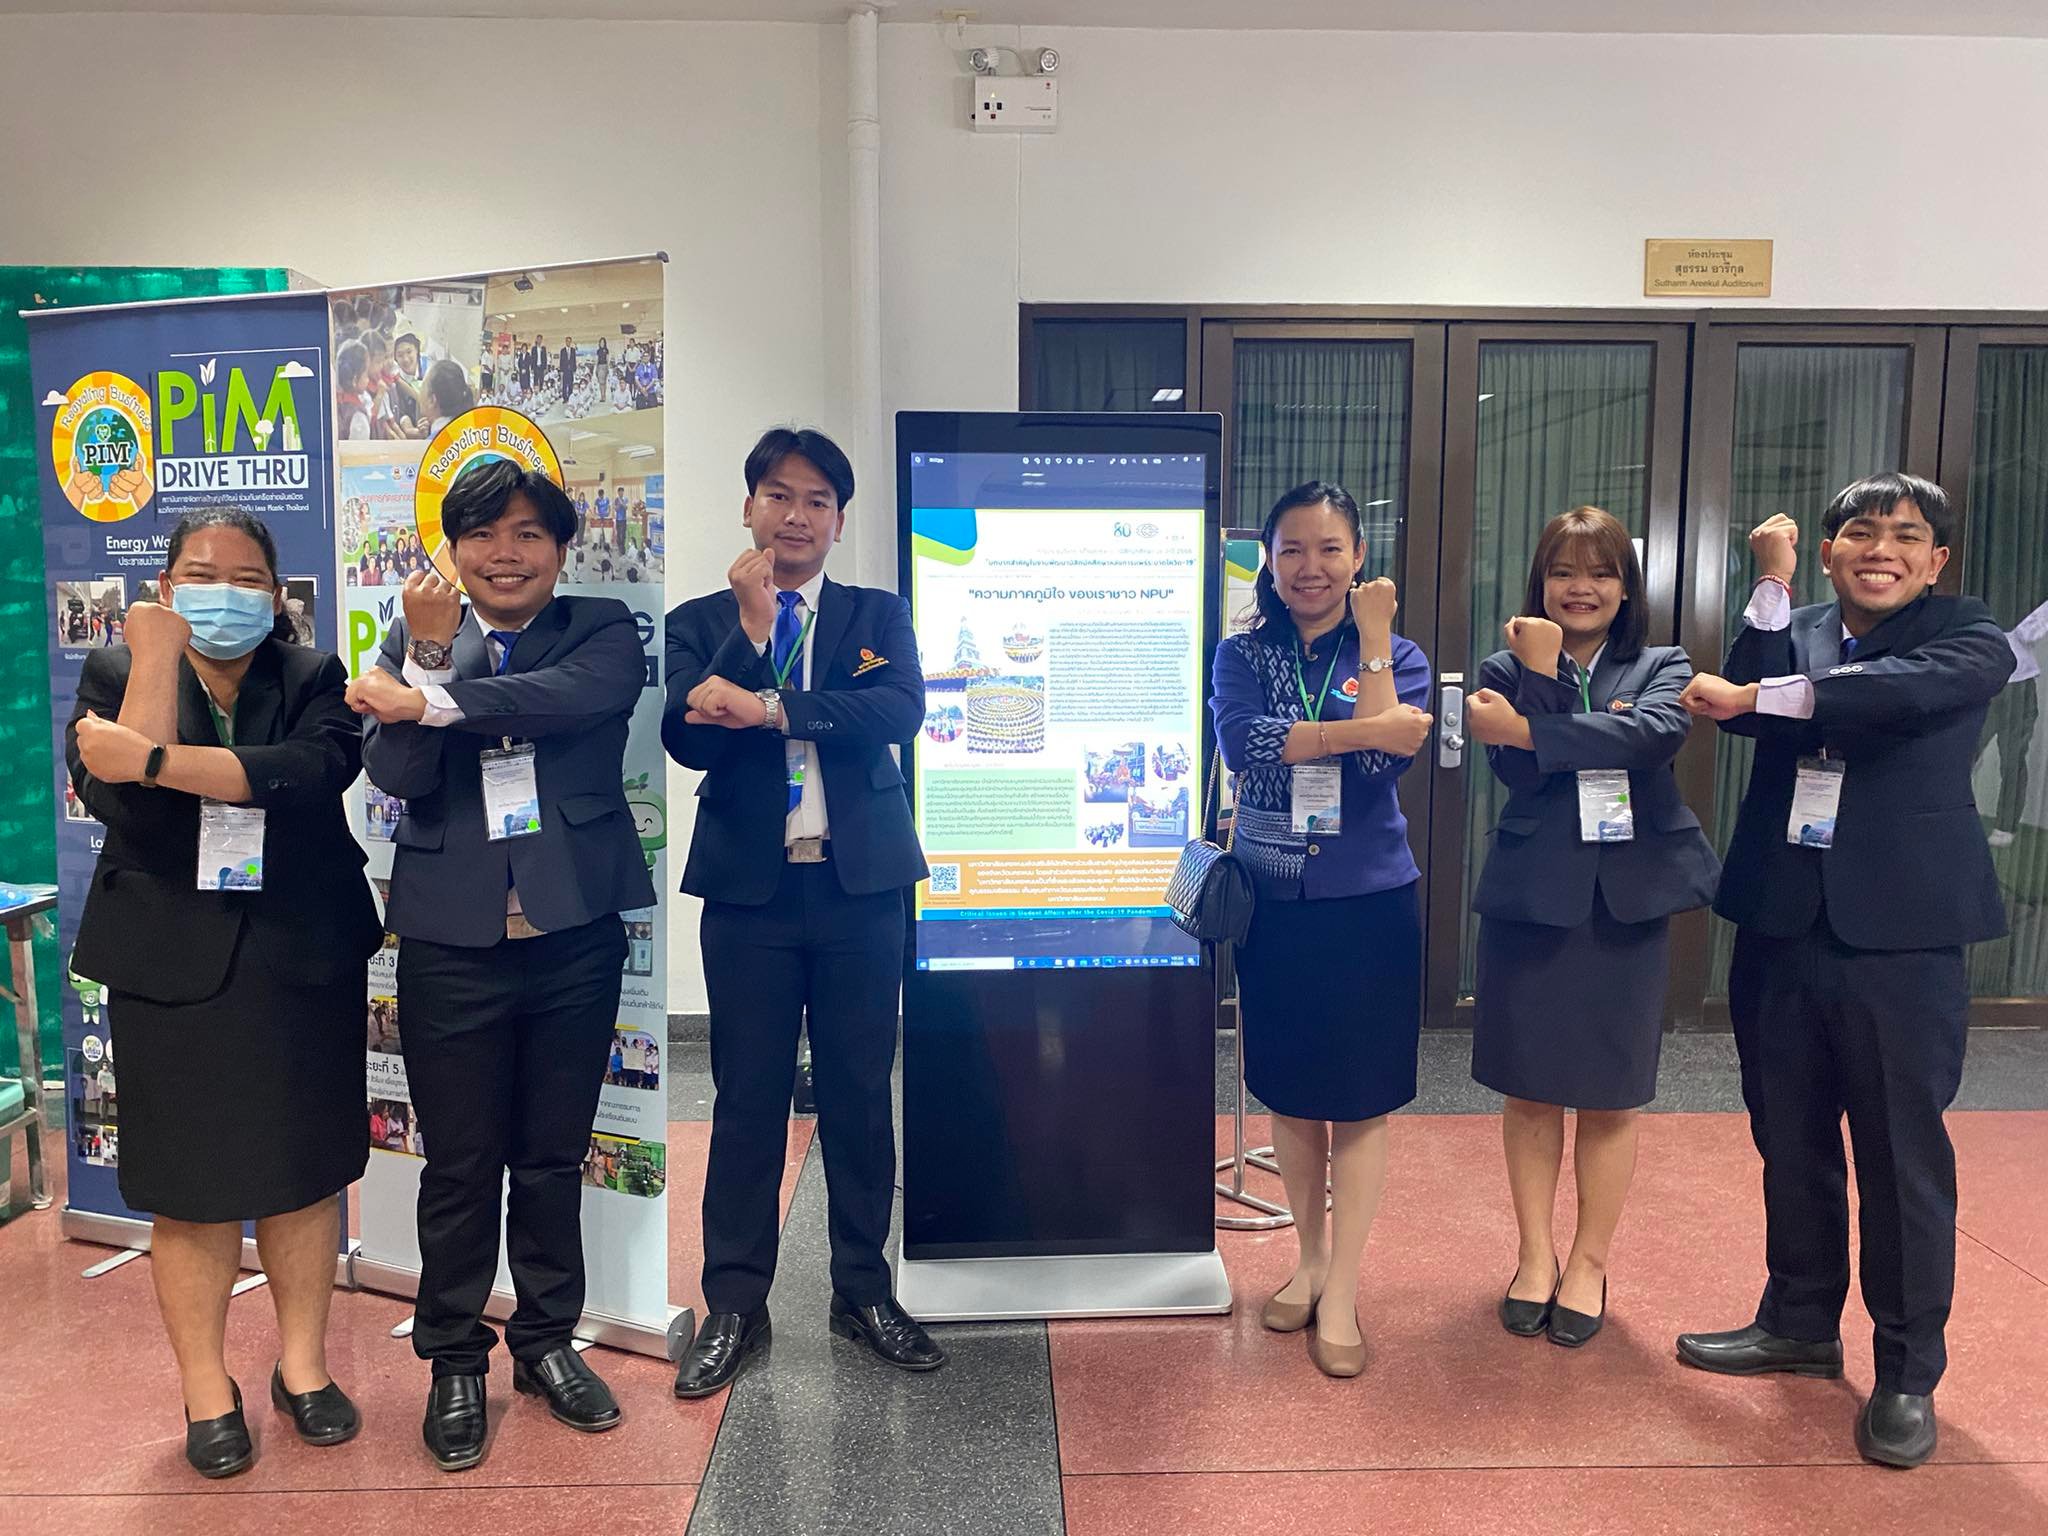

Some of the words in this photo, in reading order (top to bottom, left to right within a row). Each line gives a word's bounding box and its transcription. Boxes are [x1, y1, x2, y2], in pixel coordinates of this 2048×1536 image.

[1722, 279, 1764, 288] Auditorium
[61, 385, 106, 430] Recycling
[84, 443, 131, 465] PIM
[429, 426, 492, 480] Recycling
[161, 459, 229, 487] DRIVE
[238, 457, 306, 486] THRU
[105, 535, 149, 552] Energy
[1069, 589, 1137, 600] ของเราชาว
[1140, 588, 1174, 600] NPU"
[388, 956, 395, 968] 3
[392, 1063, 400, 1075] 5
